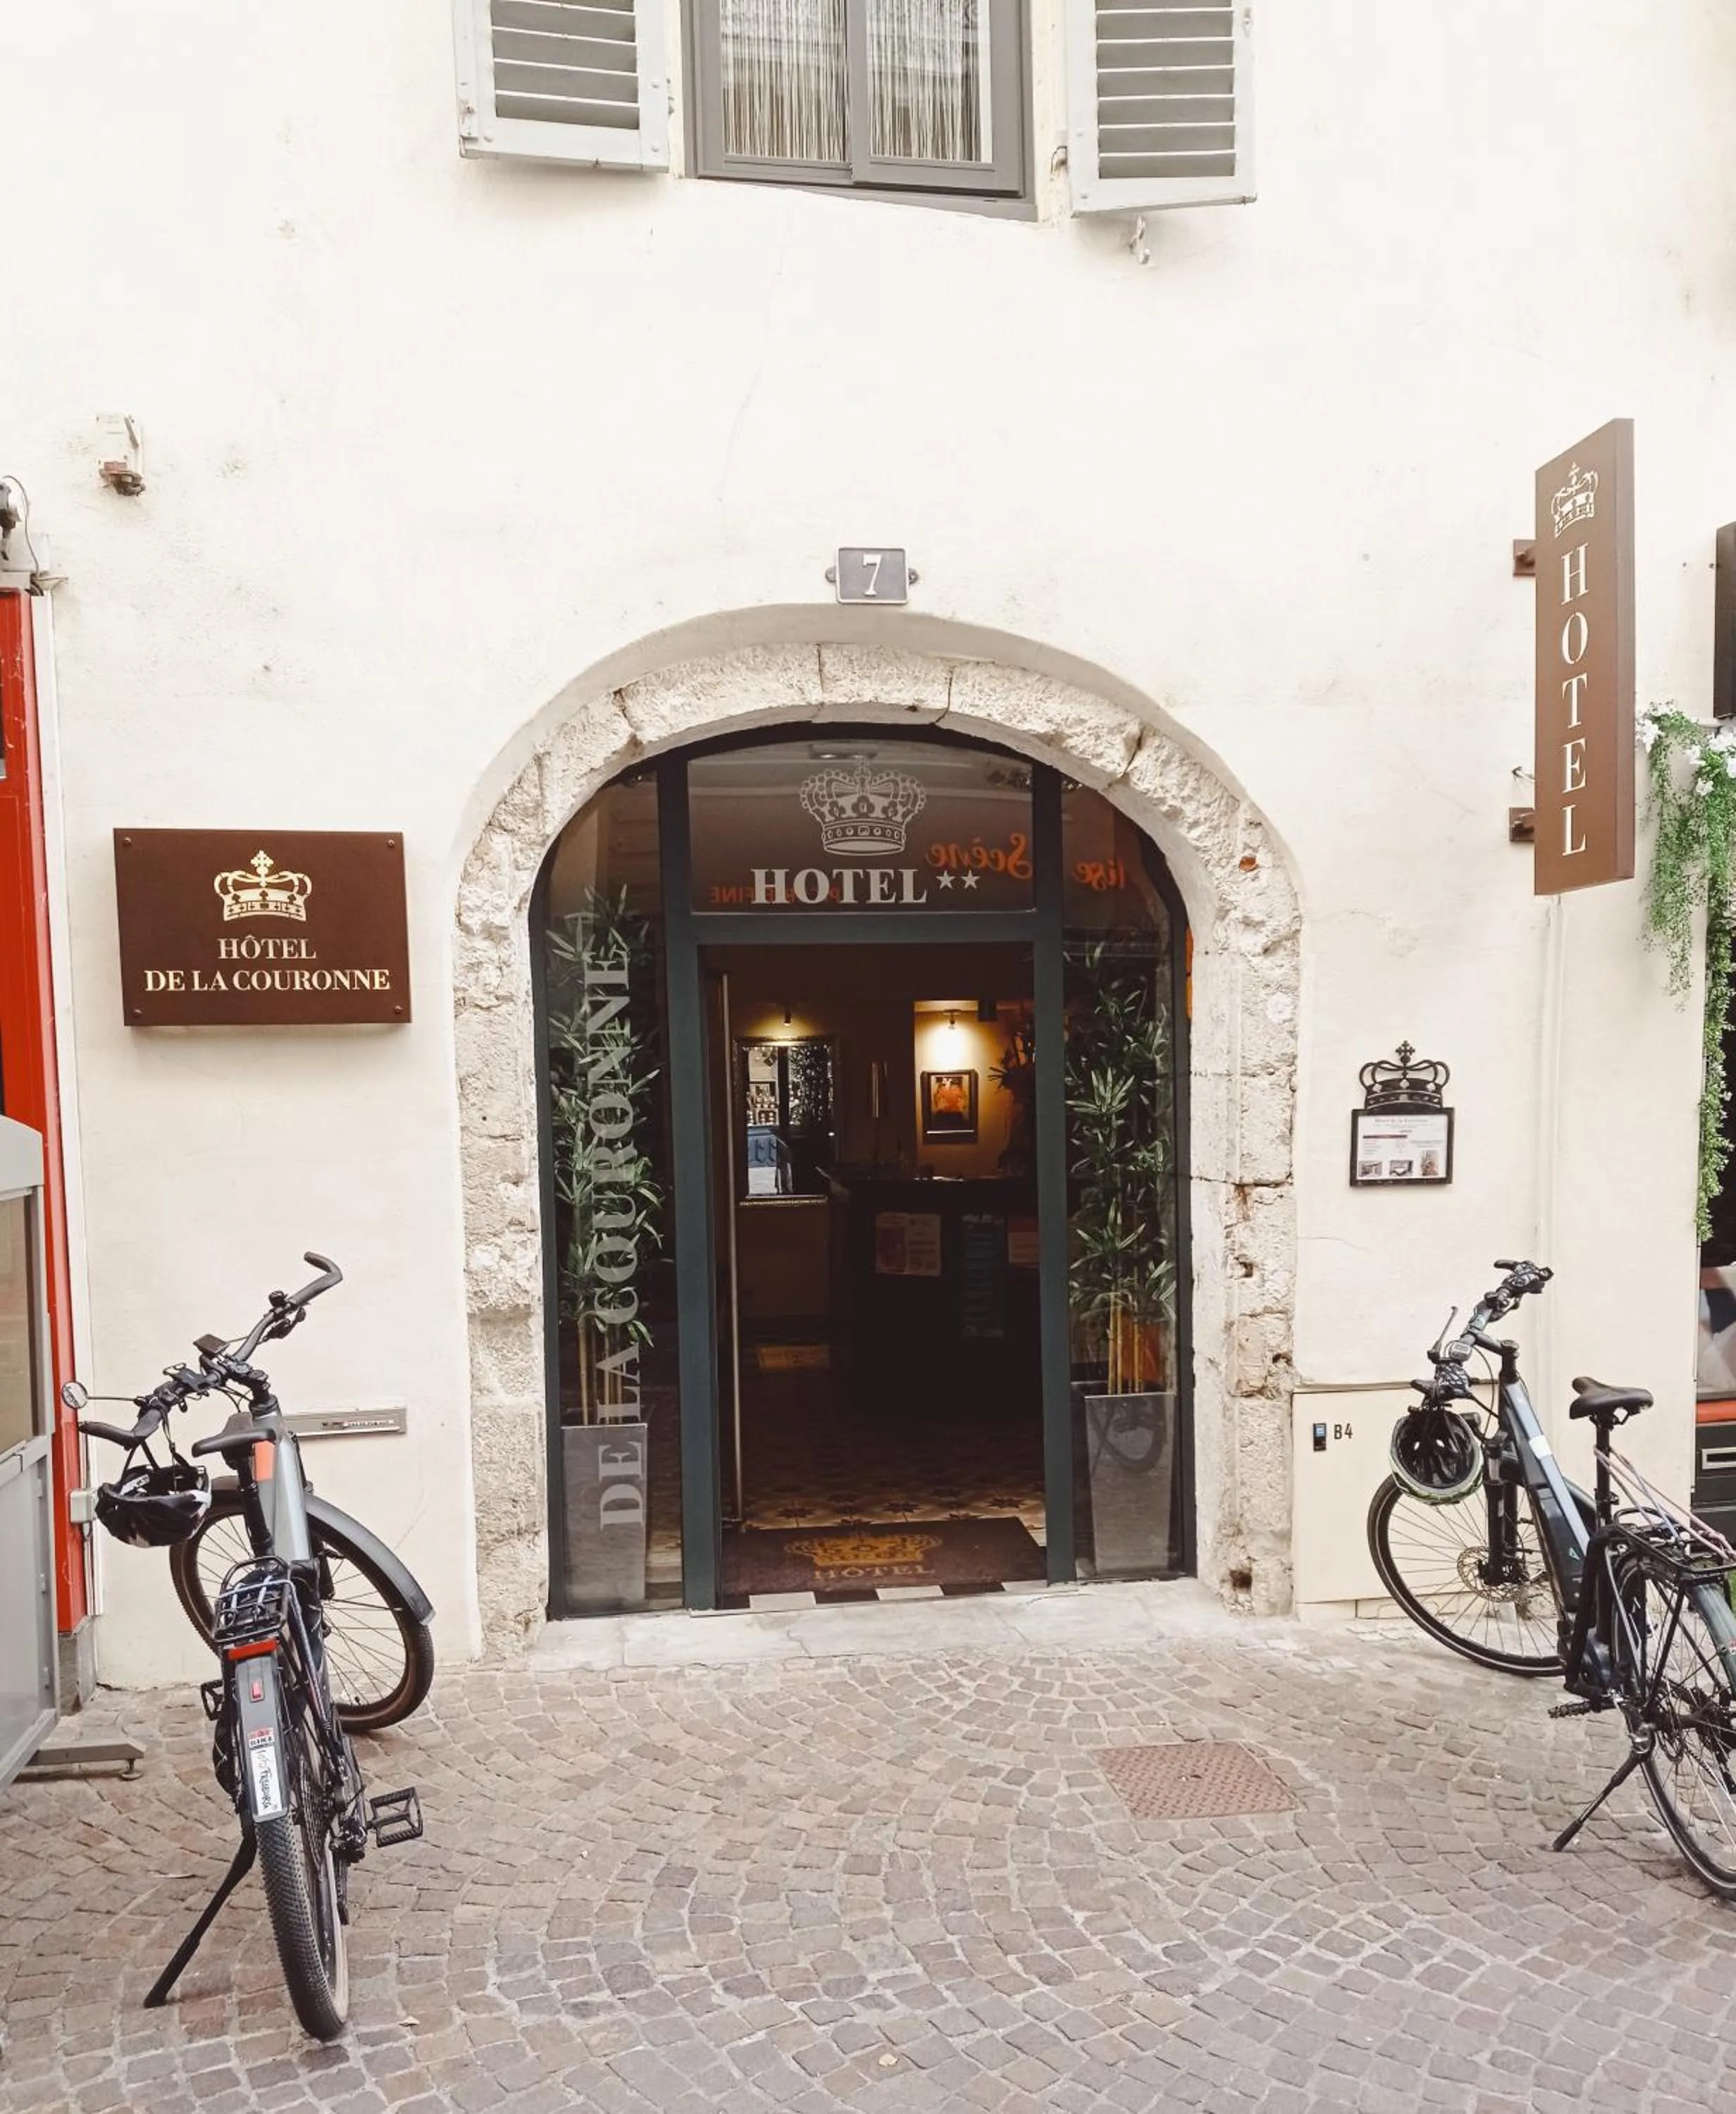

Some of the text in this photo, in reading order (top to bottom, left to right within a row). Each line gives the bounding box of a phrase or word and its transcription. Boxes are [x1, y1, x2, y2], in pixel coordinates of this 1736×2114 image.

[862, 553, 882, 595] 7
[1561, 542, 1589, 858] HOTEL
[750, 868, 927, 905] HOTEL
[217, 934, 317, 960] HÔTEL
[144, 968, 390, 991] DE LA COURONNE
[583, 950, 645, 1533] DE LA COURONNE
[1334, 1423, 1353, 1440] B4
[814, 1564, 936, 1580] HOTEL
